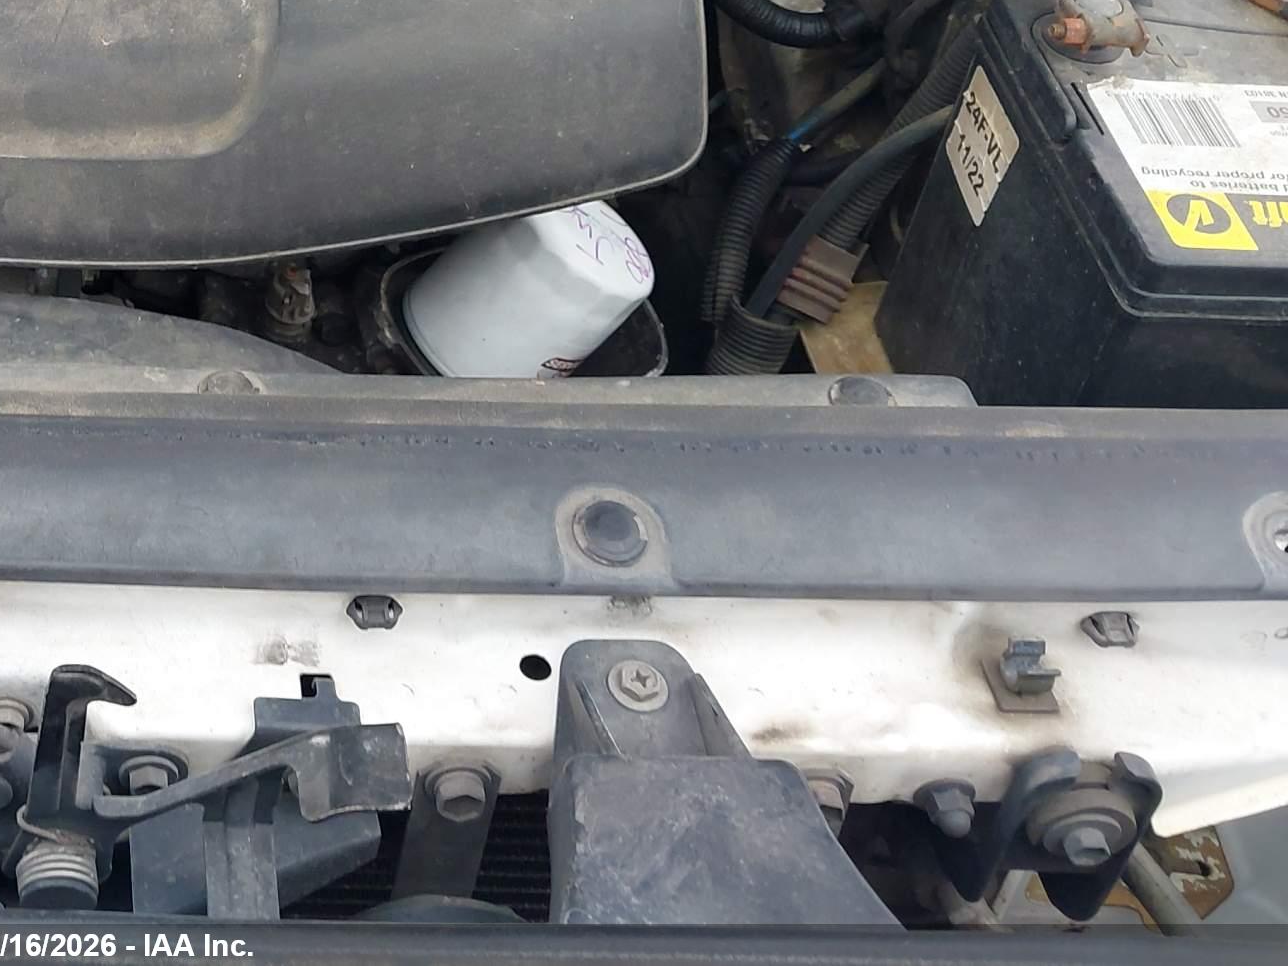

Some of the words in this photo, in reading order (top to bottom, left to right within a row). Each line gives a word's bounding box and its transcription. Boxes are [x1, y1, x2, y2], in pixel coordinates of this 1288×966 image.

[966, 91, 1001, 173] 24F-VL
[957, 134, 984, 197] 11/22
[1141, 165, 1210, 178] recycling
[1213, 170, 1265, 181] proper
[1189, 180, 1207, 189] to
[1210, 180, 1279, 193] batteries
